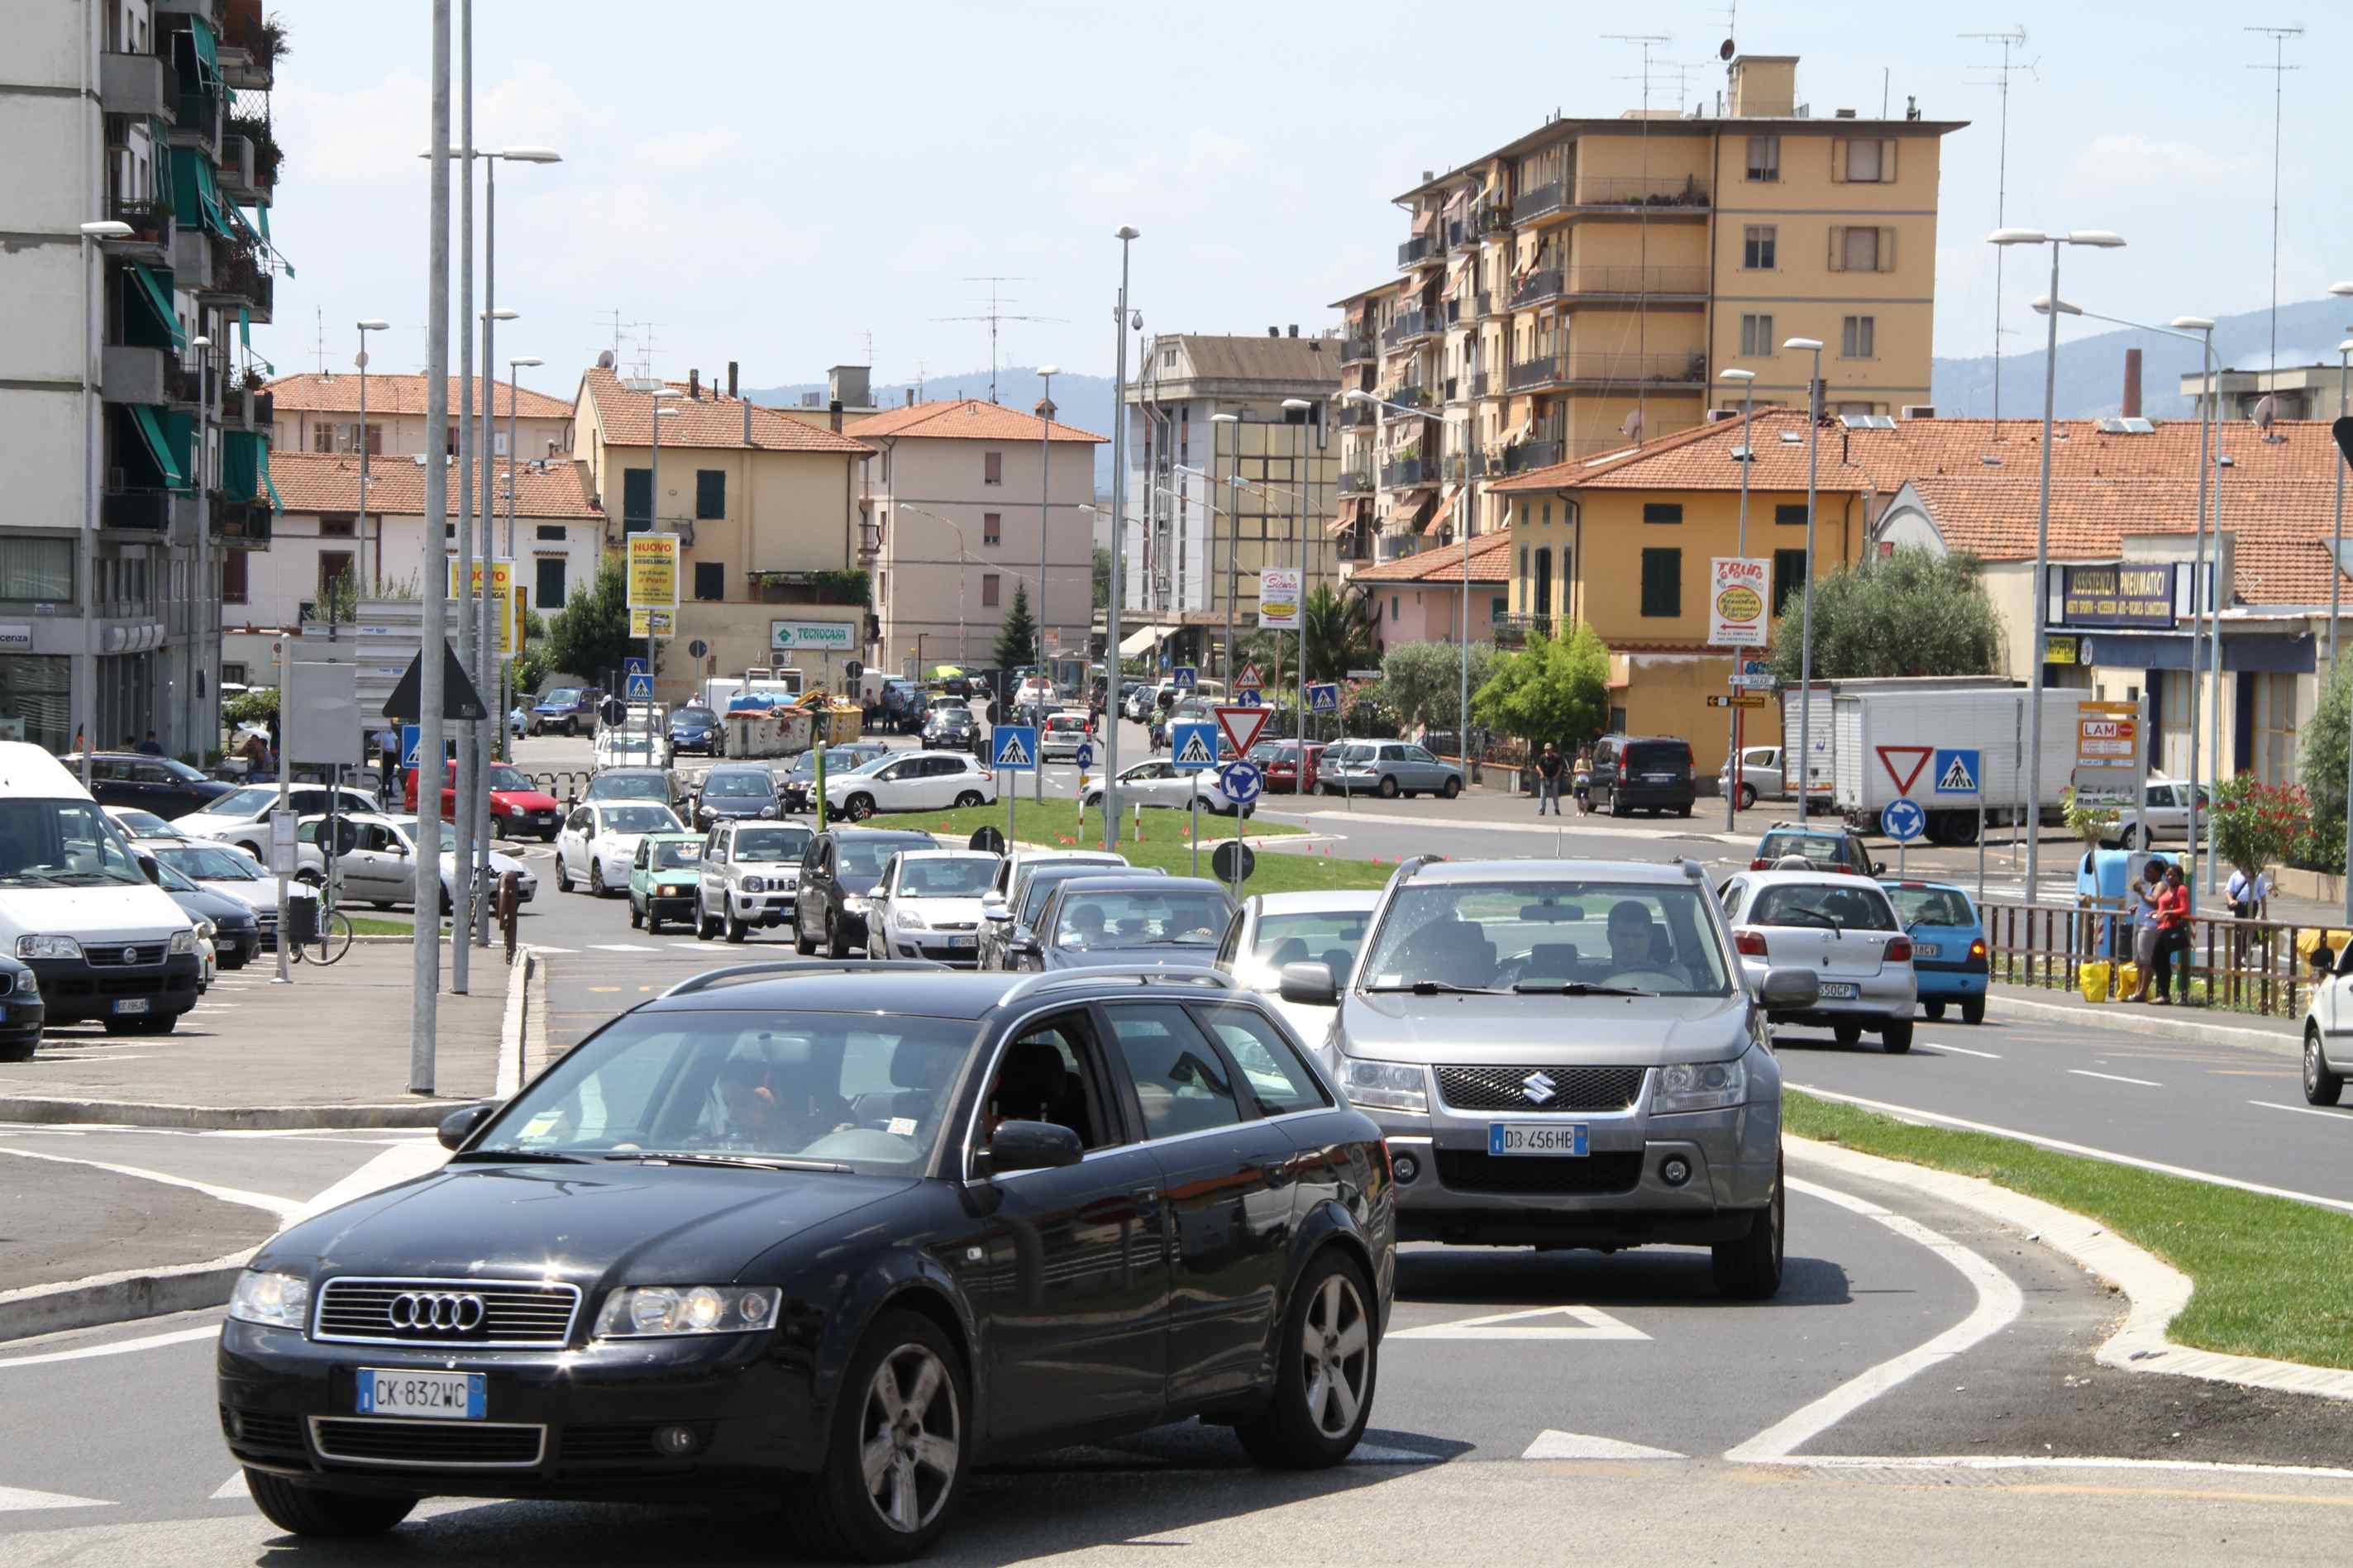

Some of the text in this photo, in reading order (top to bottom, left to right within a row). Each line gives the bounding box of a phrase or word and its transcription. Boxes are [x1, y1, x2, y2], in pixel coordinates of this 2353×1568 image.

[633, 542, 671, 552] NUOVO
[2072, 571, 2164, 596] ASSISTENZA PNEUMATICI
[2084, 723, 2115, 736] LAM
